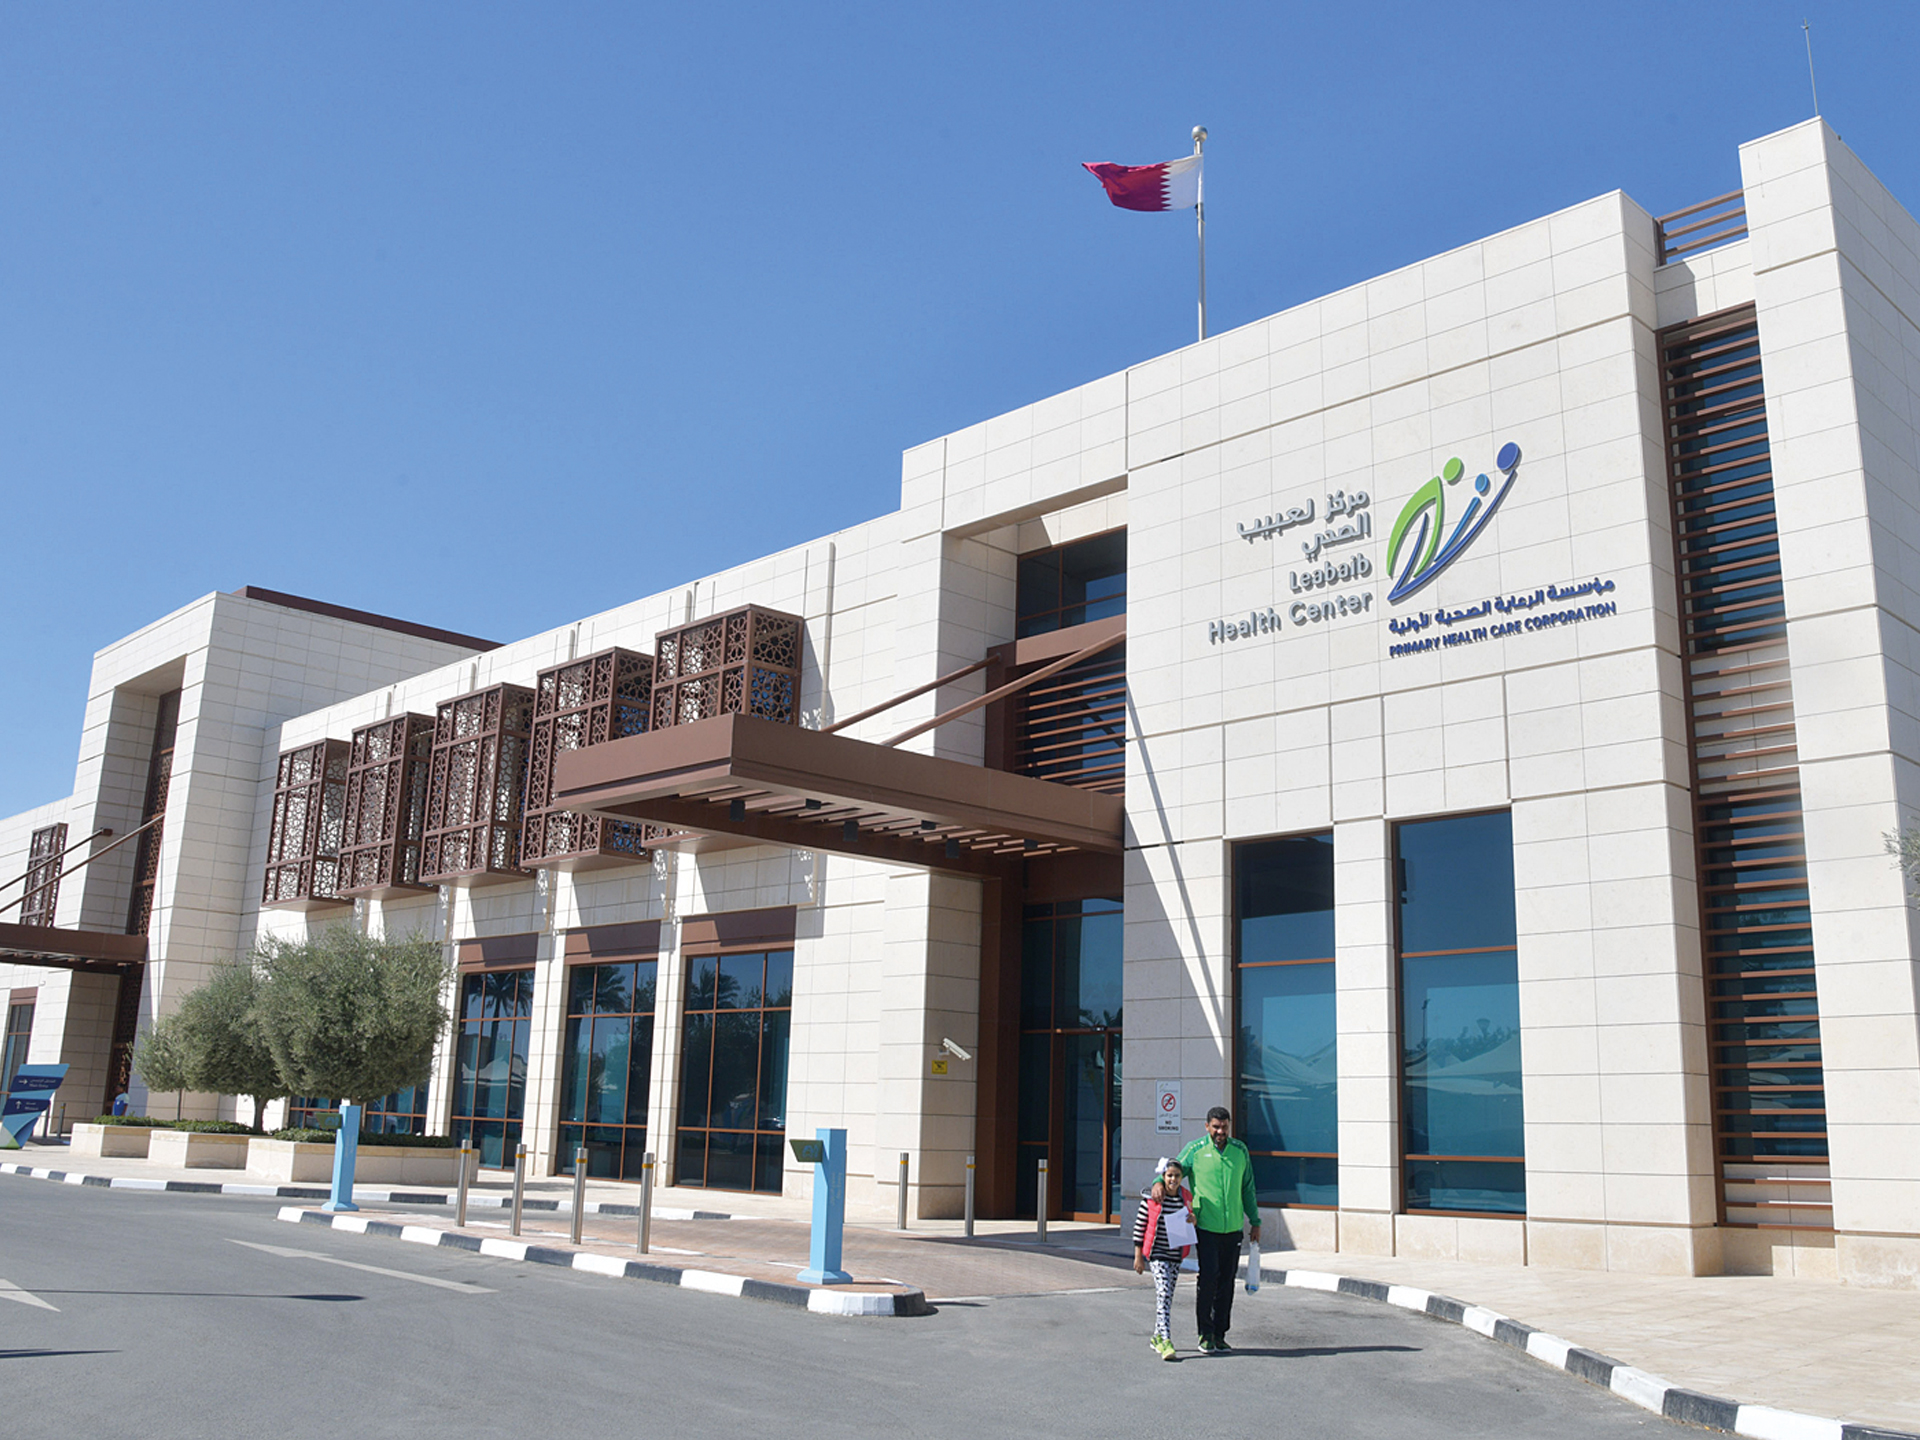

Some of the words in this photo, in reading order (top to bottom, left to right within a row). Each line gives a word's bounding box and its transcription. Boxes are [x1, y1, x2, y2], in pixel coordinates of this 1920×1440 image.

[1237, 498, 1315, 543] لعبيب
[1324, 490, 1369, 522] مركز
[1302, 512, 1371, 562] الصحي
[1290, 553, 1372, 593] Leabaib
[1547, 577, 1615, 600] مؤسسة
[1209, 607, 1282, 645] Health
[1289, 592, 1373, 626] Center
[1435, 600, 1492, 626] الصحية
[1494, 590, 1545, 614] الرعاية
[1389, 636, 1440, 658] PRIMARY
[1442, 627, 1488, 648] HEALTH
[1490, 620, 1522, 638] CARE
[1524, 601, 1617, 631] CORPORATION
